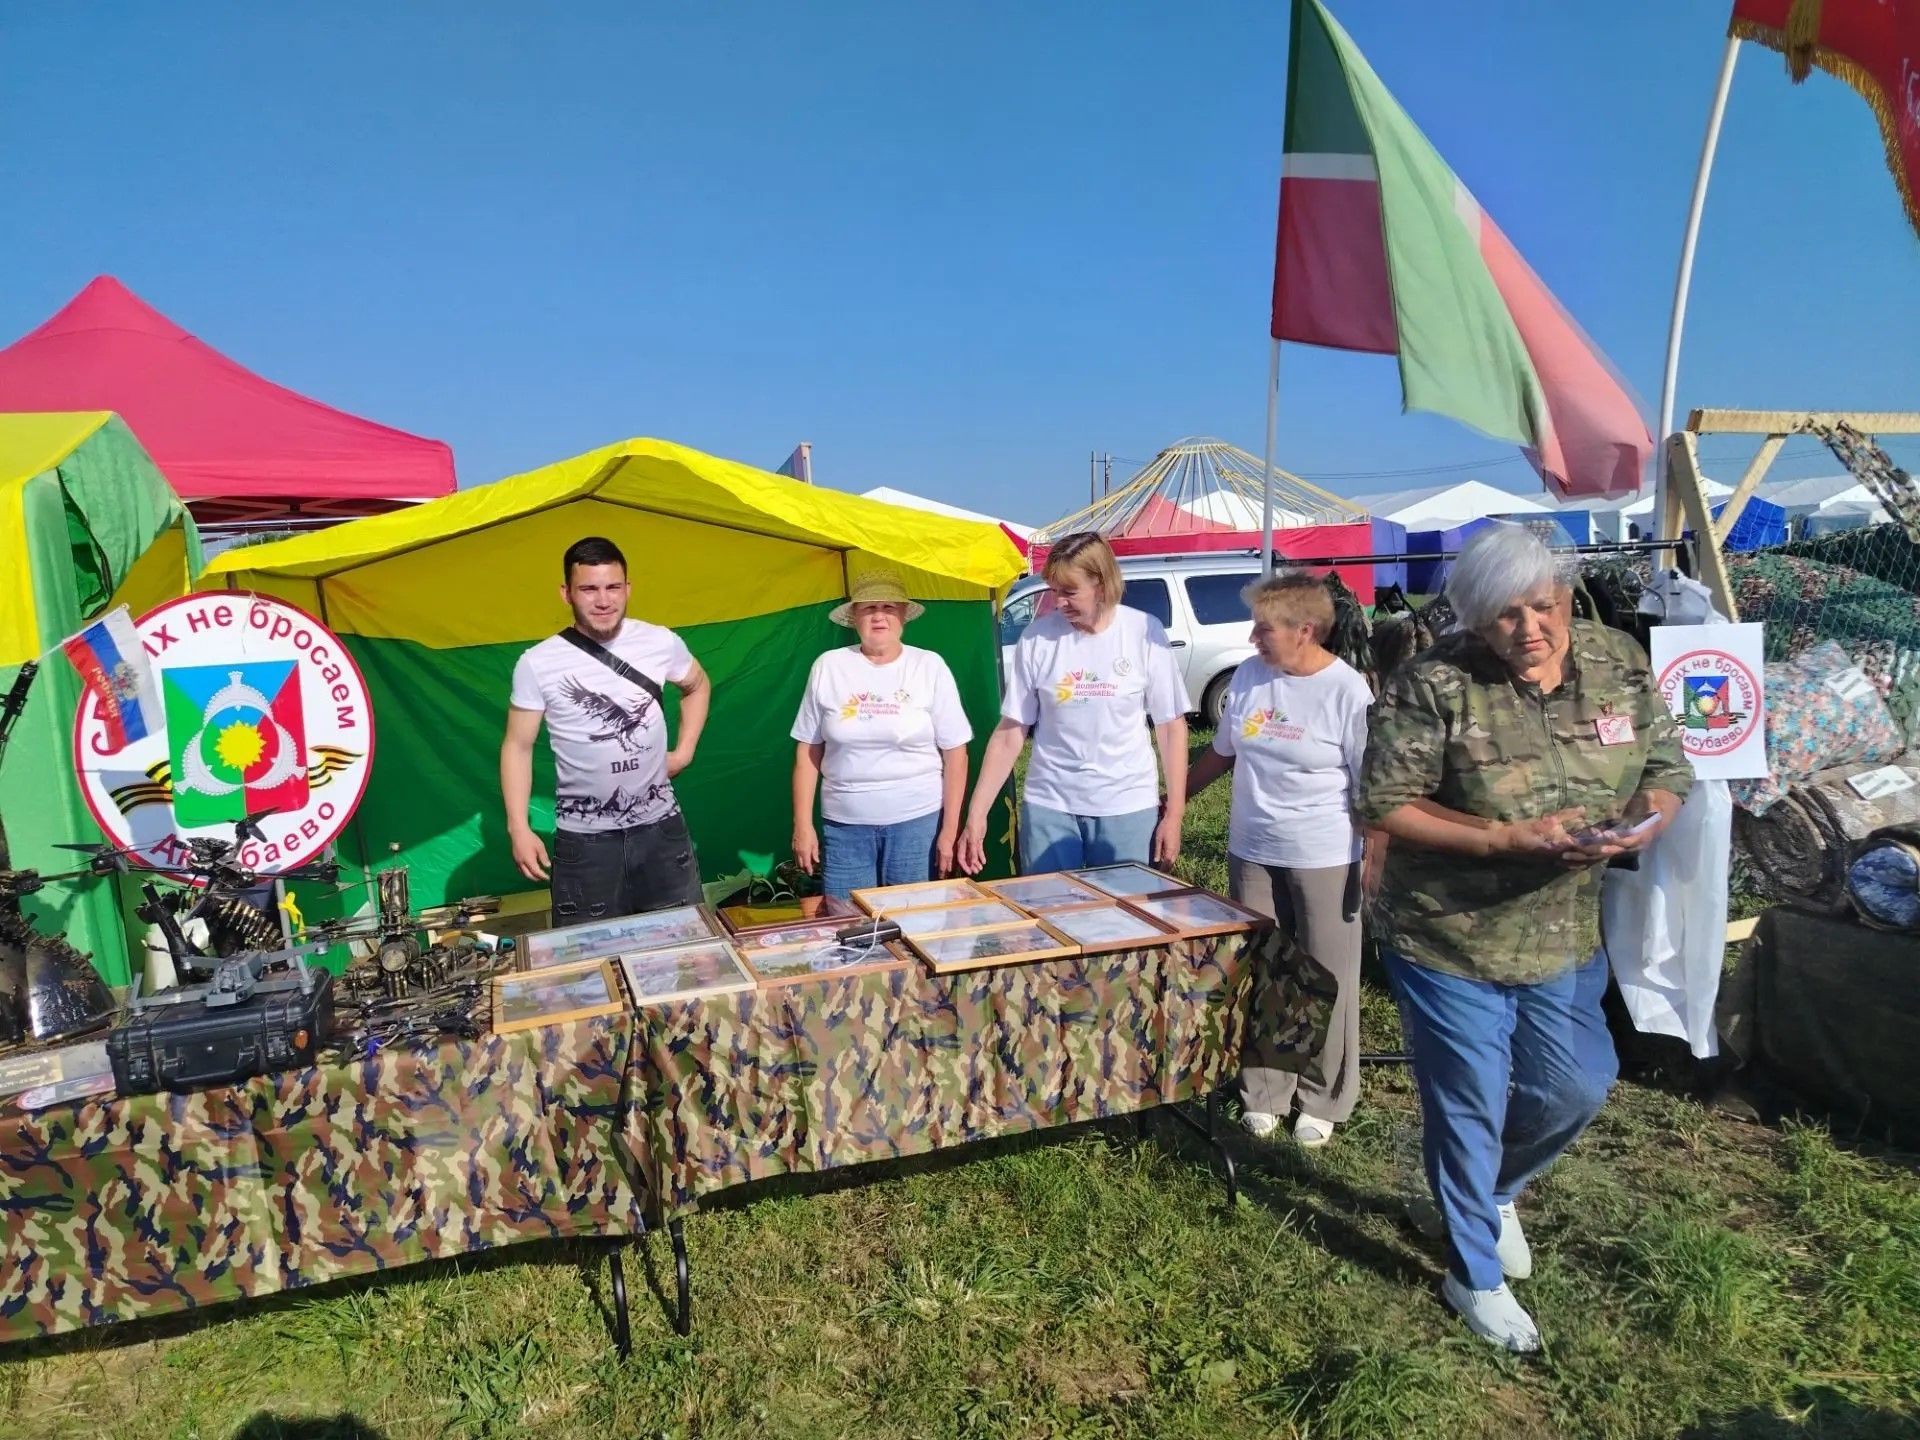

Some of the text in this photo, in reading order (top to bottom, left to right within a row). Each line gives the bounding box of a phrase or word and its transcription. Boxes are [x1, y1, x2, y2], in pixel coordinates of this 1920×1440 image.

[186, 604, 234, 634] не
[249, 602, 356, 730] бросаем
[1691, 658, 1711, 670] не
[1714, 657, 1753, 711] бросаем
[610, 757, 640, 774] DAG
[149, 801, 336, 870] Абаево
